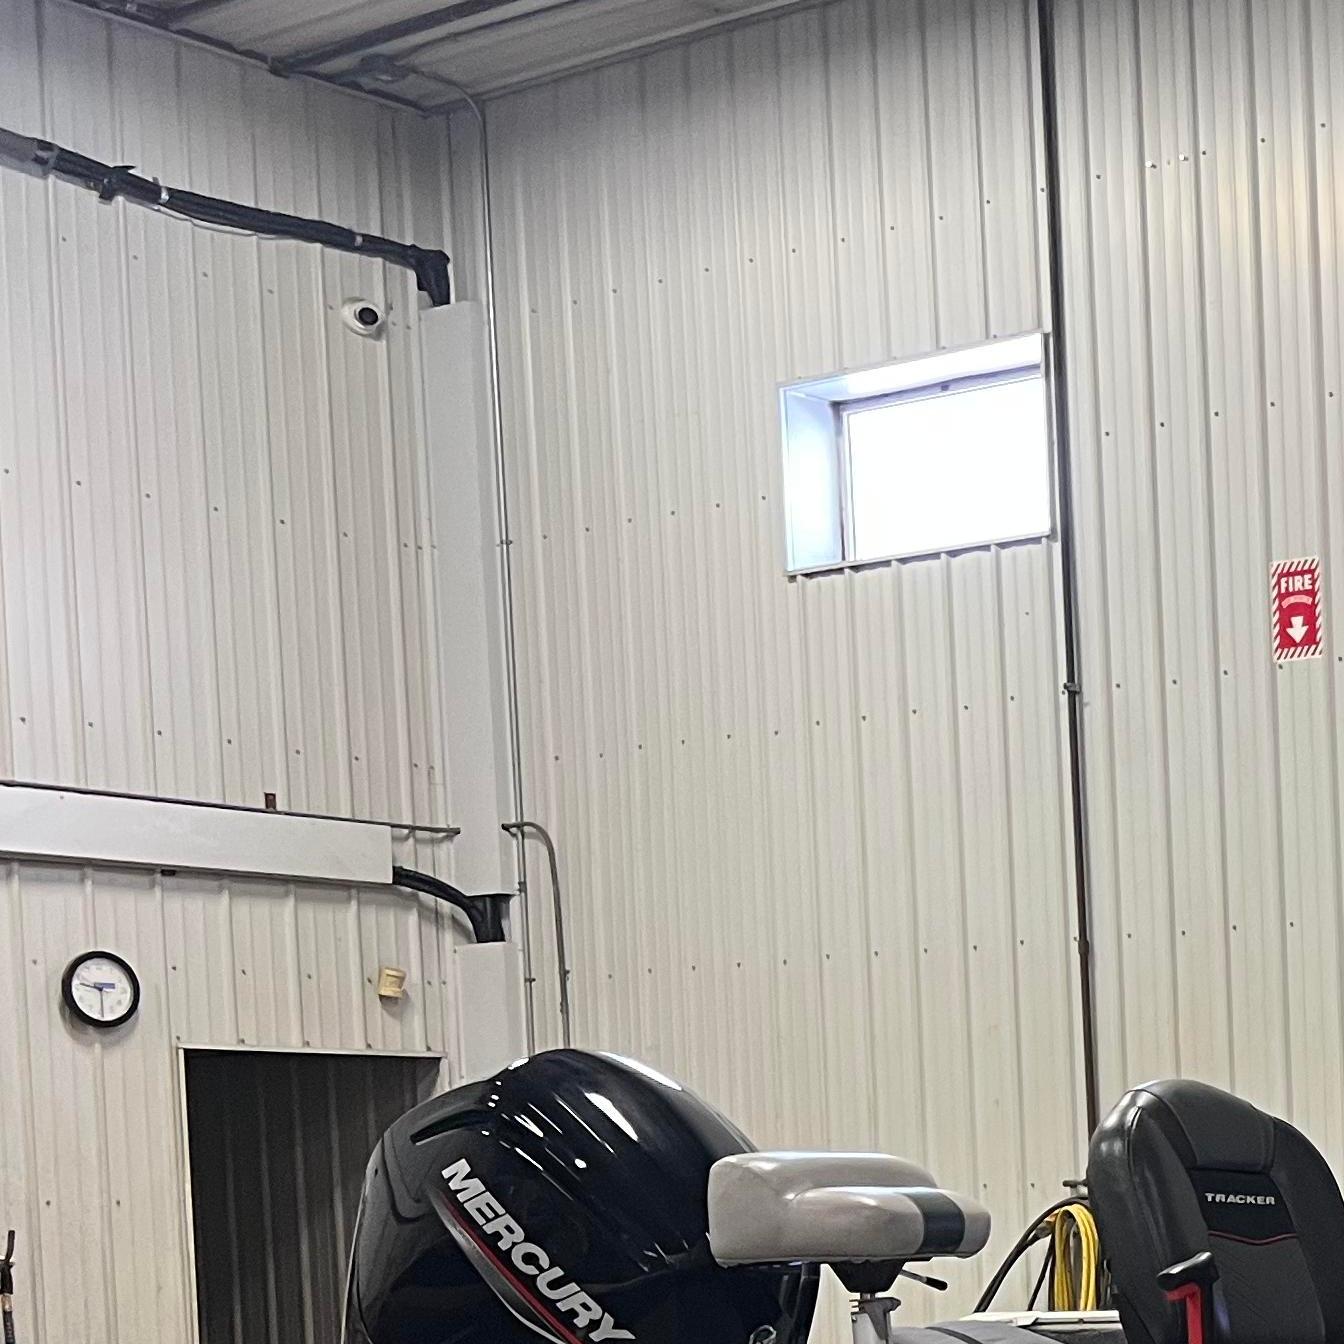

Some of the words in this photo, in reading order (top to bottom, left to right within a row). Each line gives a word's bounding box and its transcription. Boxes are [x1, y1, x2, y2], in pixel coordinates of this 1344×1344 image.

[1280, 574, 1313, 593] FIRE
[1204, 1192, 1276, 1205] TRACKER
[441, 1158, 636, 1342] MERCURY
